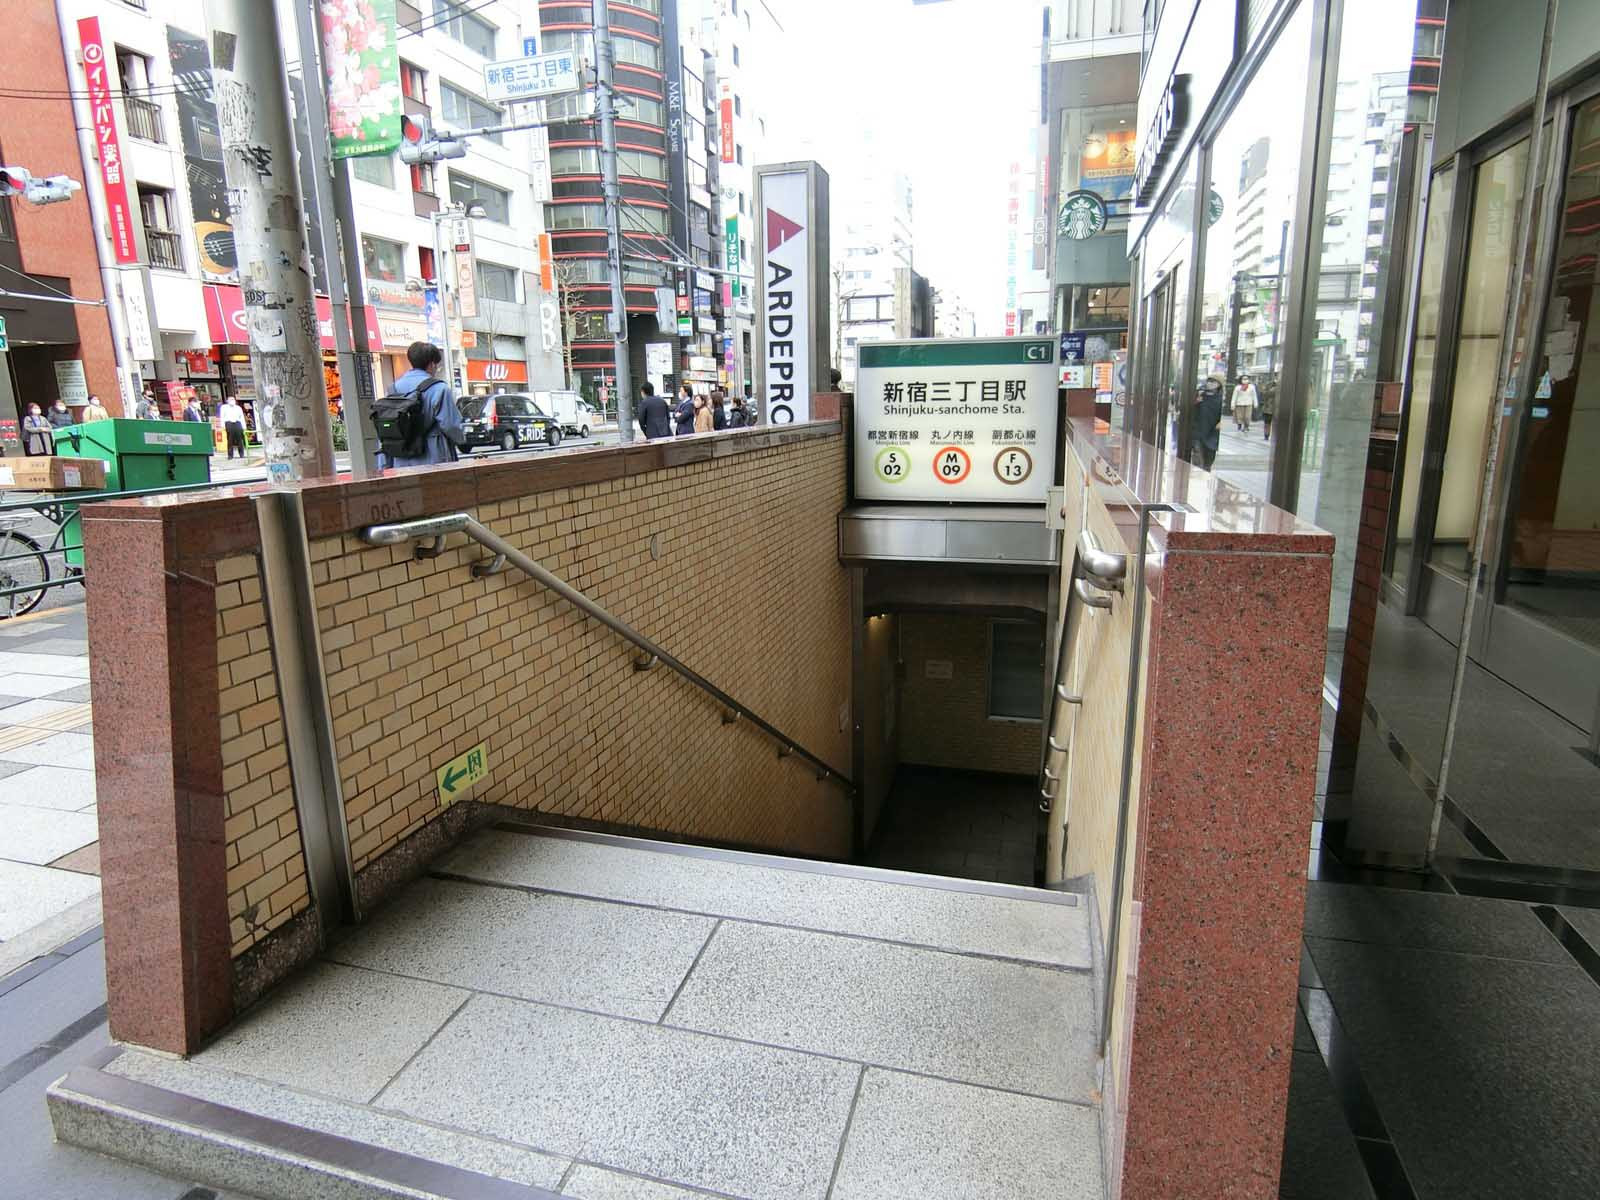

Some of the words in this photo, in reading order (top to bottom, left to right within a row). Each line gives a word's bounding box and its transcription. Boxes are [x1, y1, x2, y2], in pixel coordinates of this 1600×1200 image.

[487, 57, 573, 85] 新宿三丁目東
[506, 82, 539, 94] Shinjuku
[668, 81, 680, 112] M&E
[1027, 346, 1046, 360] C1
[485, 364, 508, 380] au
[883, 379, 1027, 403] 新宿三丁目駅
[884, 403, 998, 417] Shinjuku-sanchome
[1002, 403, 1025, 415] Sta.
[518, 428, 546, 441] S.RIDE
[867, 430, 919, 440] 都営新宿線
[931, 430, 974, 440] 丸ノ内線
[992, 429, 1036, 440] 副都心線
[889, 453, 896, 463] S
[946, 453, 958, 463] M
[1010, 453, 1016, 463] F
[884, 465, 901, 475] 02
[943, 465, 960, 476] 09
[1005, 465, 1022, 476] 13
